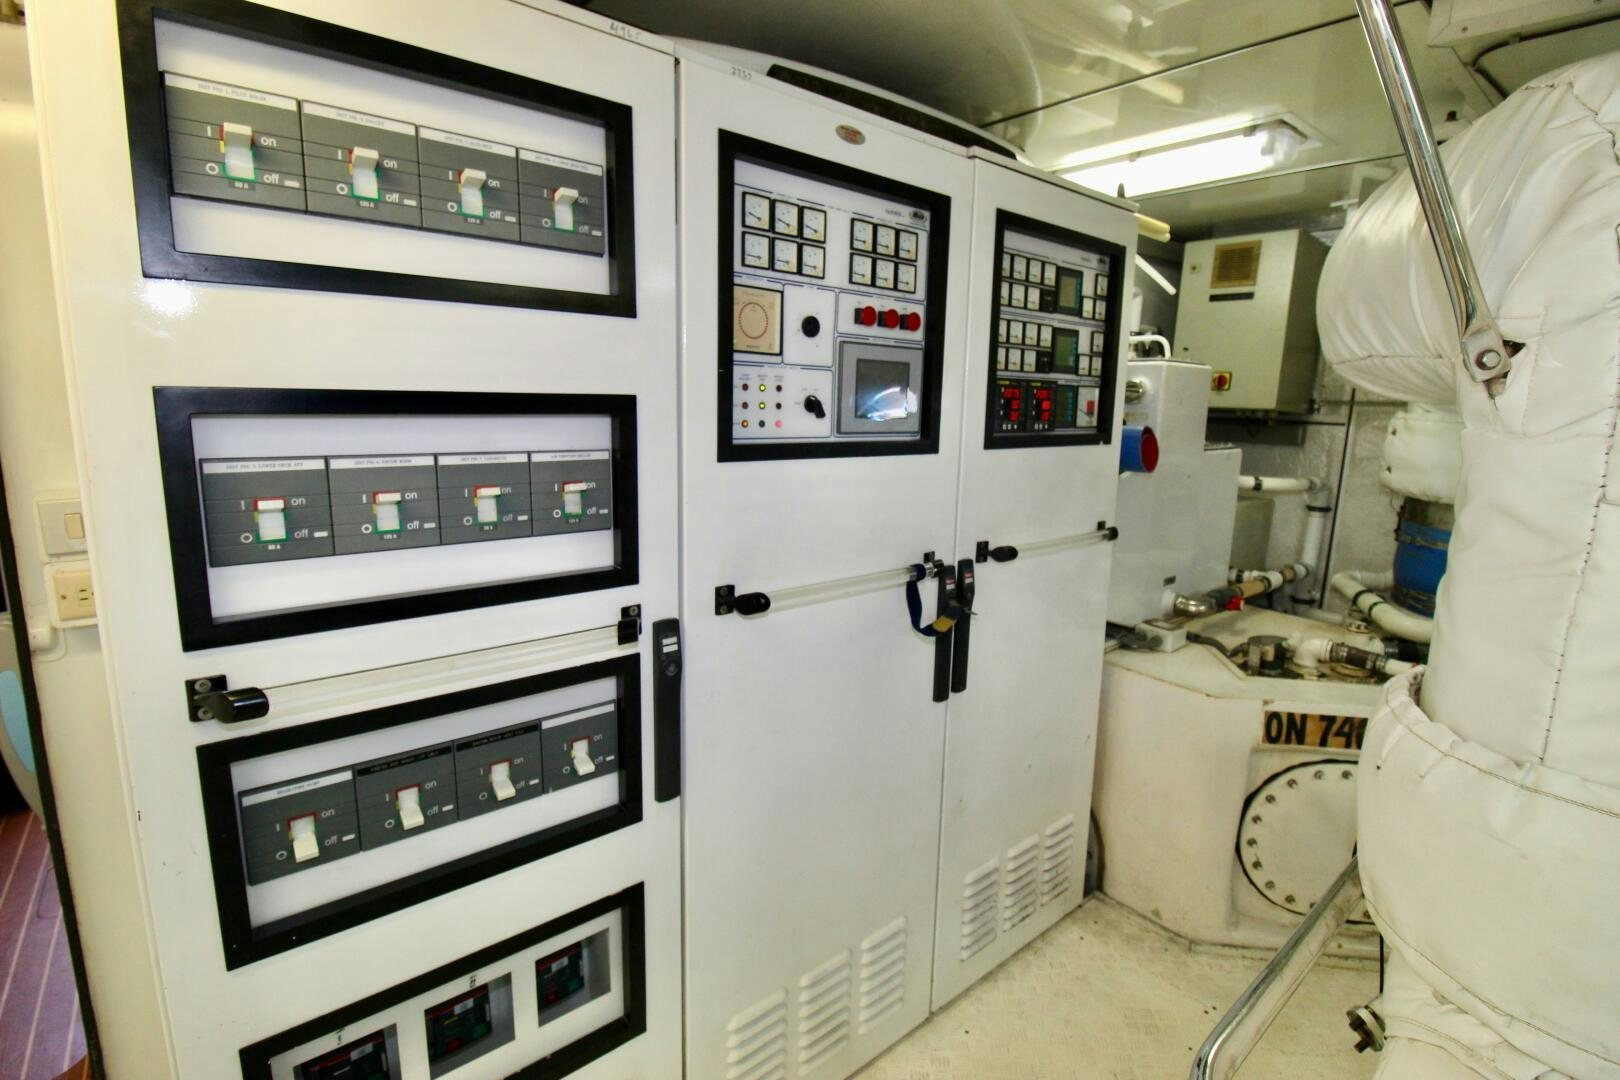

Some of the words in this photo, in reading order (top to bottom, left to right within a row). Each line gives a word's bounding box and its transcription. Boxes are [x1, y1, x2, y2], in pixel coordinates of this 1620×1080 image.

[261, 137, 277, 146] on
[384, 160, 397, 168] on
[264, 174, 280, 184] off
[488, 179, 500, 187] on
[386, 194, 399, 203] off
[490, 210, 501, 219] off
[407, 521, 419, 529] off
[295, 529, 308, 538] off
[1265, 711, 1307, 745] ON
[595, 756, 603, 764] off
[425, 780, 437, 789] on
[516, 781, 525, 789] off
[322, 809, 335, 818] on
[427, 805, 439, 816] off
[325, 835, 337, 846] off
